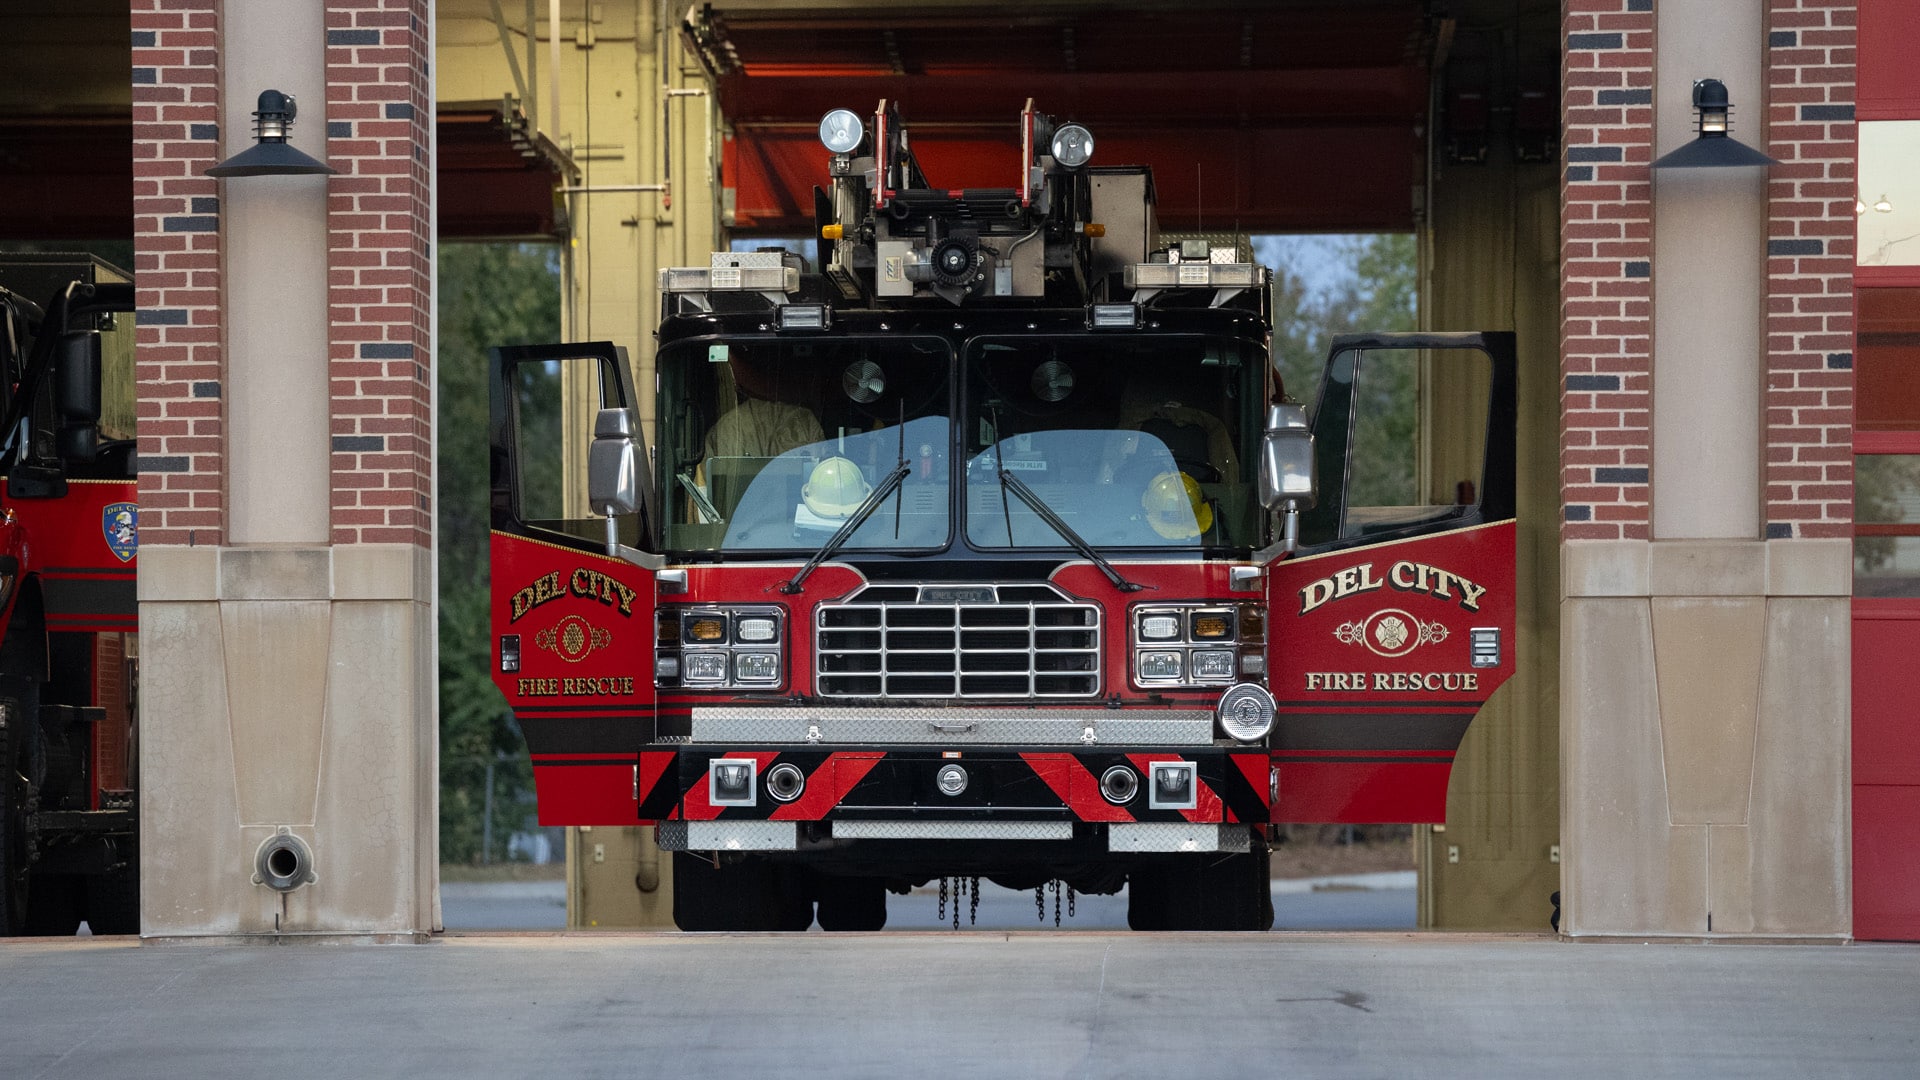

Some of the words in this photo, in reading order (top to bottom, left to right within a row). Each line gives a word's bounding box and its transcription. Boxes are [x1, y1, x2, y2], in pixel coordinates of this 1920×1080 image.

[511, 570, 567, 623] DEL
[571, 567, 637, 616] CITY
[1299, 563, 1383, 616] DEL
[1388, 560, 1486, 613] CITY
[518, 678, 558, 696] FIRE
[562, 677, 634, 696] RESCUE
[1305, 672, 1367, 691] FIRE
[1372, 672, 1478, 691] RESCUE
